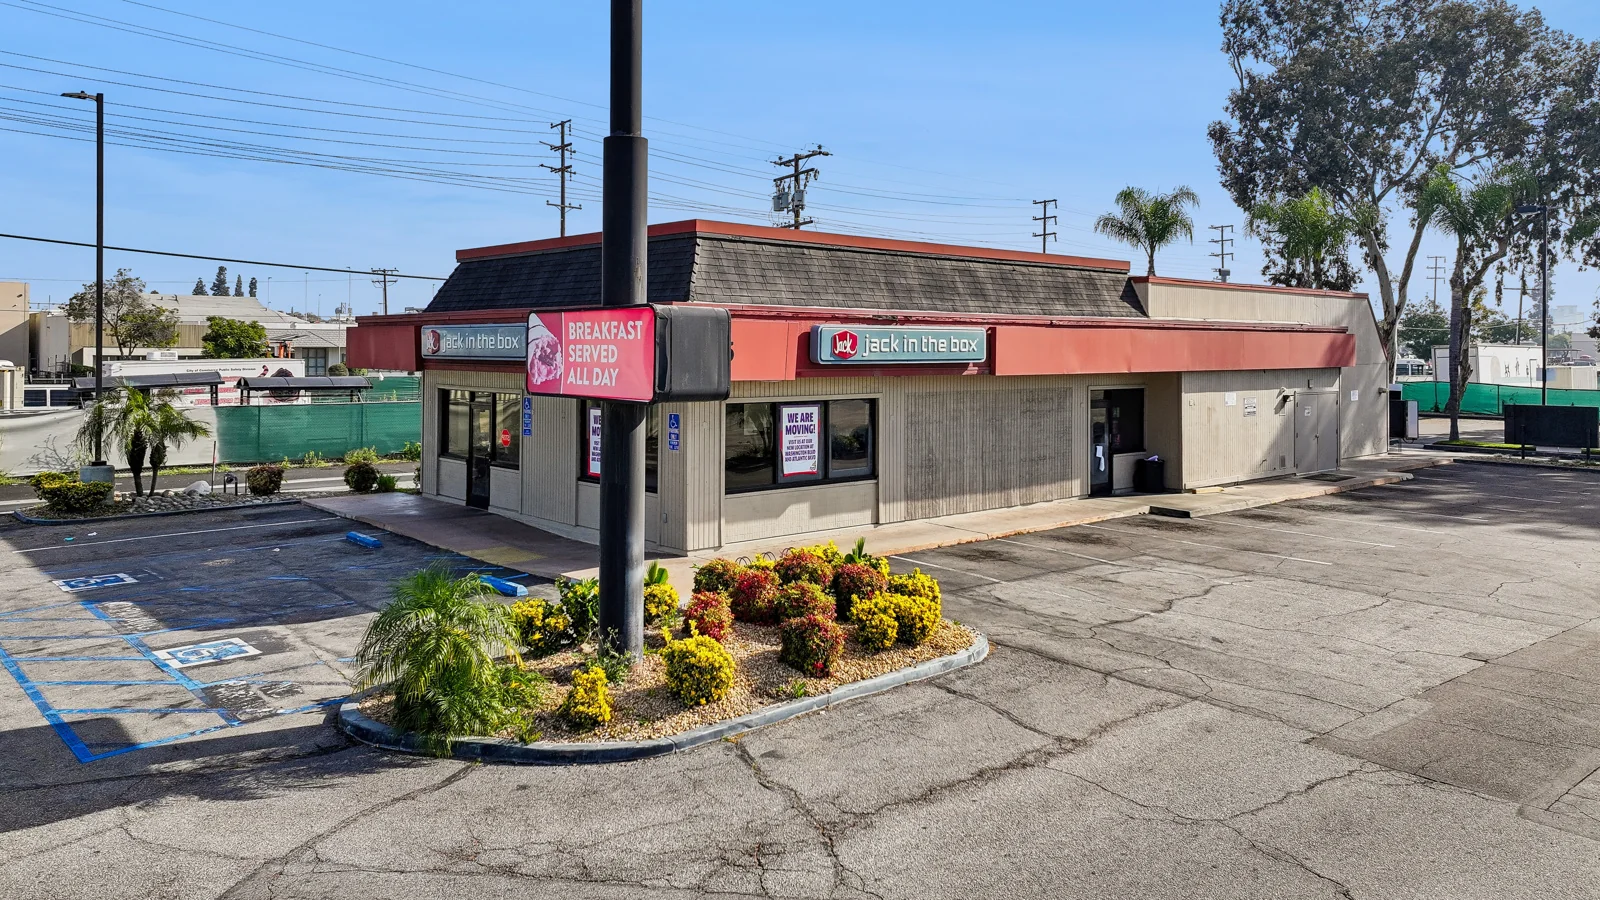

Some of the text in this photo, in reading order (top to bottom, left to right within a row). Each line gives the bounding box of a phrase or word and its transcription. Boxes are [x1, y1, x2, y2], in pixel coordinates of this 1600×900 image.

[568, 320, 643, 340] BREAKFAST
[442, 332, 519, 353] jack in the box
[834, 333, 857, 354] Jack
[862, 333, 977, 357] jack in the box
[568, 344, 618, 363] SERVED
[567, 366, 619, 387] ALL DAY
[787, 412, 814, 424] WE ARE
[785, 423, 816, 436] MOVING!
